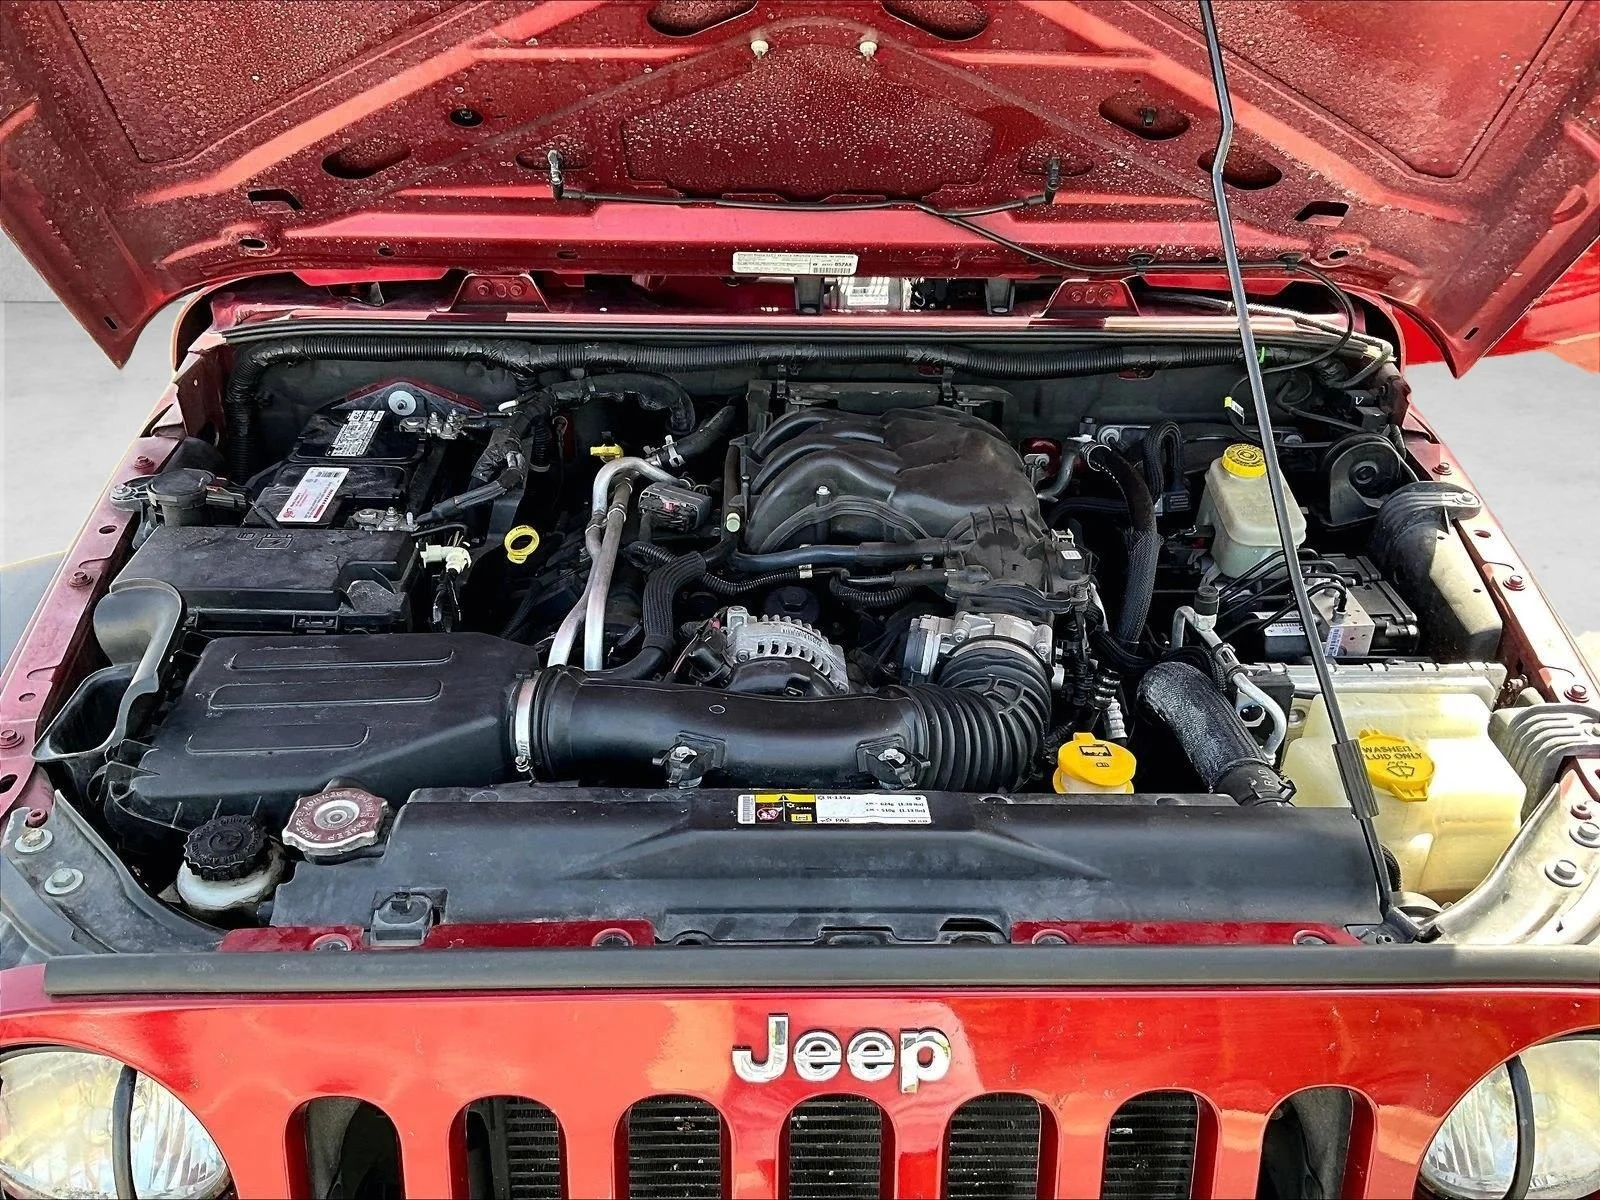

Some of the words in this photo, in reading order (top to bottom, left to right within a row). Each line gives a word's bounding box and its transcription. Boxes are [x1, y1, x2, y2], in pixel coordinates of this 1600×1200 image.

[1361, 745, 1412, 753] WASHER
[1393, 752, 1423, 761] ONLY
[732, 1012, 952, 1094] Jeep
